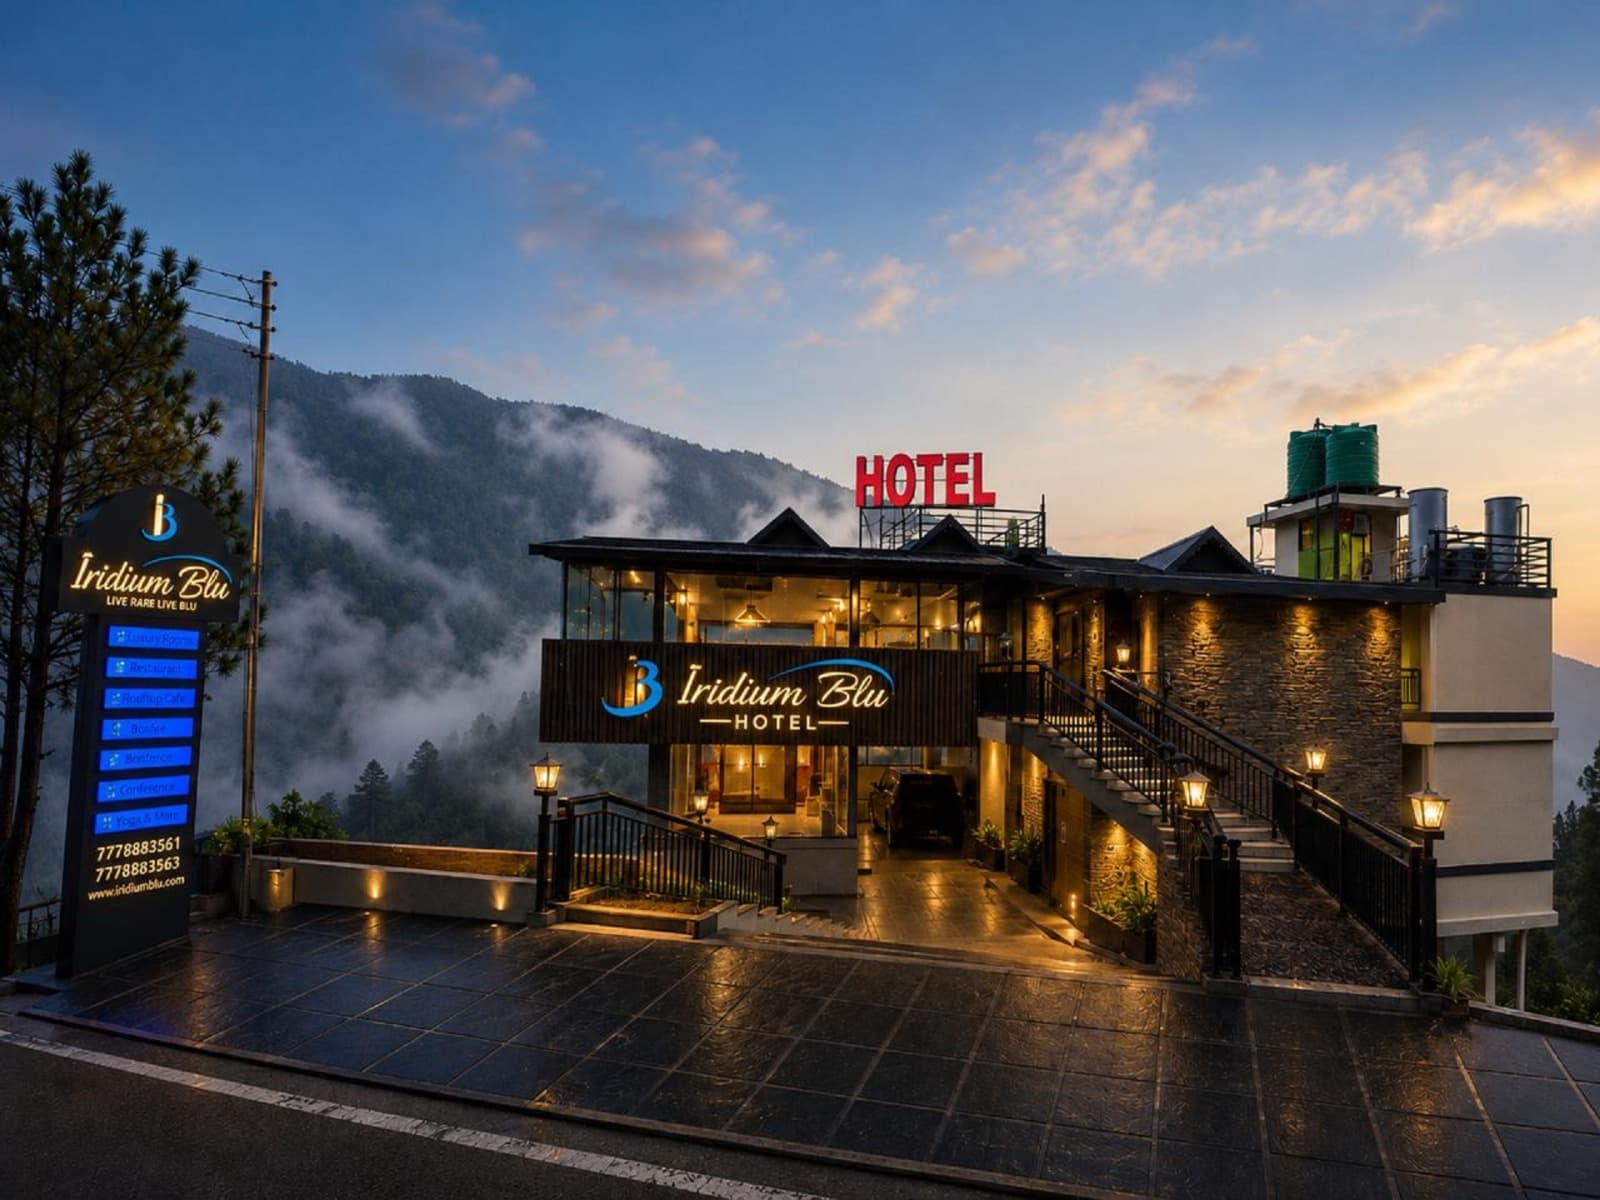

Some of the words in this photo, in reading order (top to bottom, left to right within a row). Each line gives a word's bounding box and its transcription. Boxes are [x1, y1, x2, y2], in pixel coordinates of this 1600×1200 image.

[856, 452, 996, 508] HOTEL
[178, 565, 230, 600] Blu
[106, 595, 128, 606] LIVE
[130, 597, 155, 608] RARE
[157, 599, 177, 610] LIVE
[179, 600, 198, 611] BLU
[817, 671, 889, 708] Blu
[735, 714, 817, 730] HOTEL
[116, 814, 142, 828] Yoga
[97, 836, 181, 862] 7778883561
[95, 856, 180, 883] 7778883563
[88, 876, 185, 900] www.iridiumblu.com
